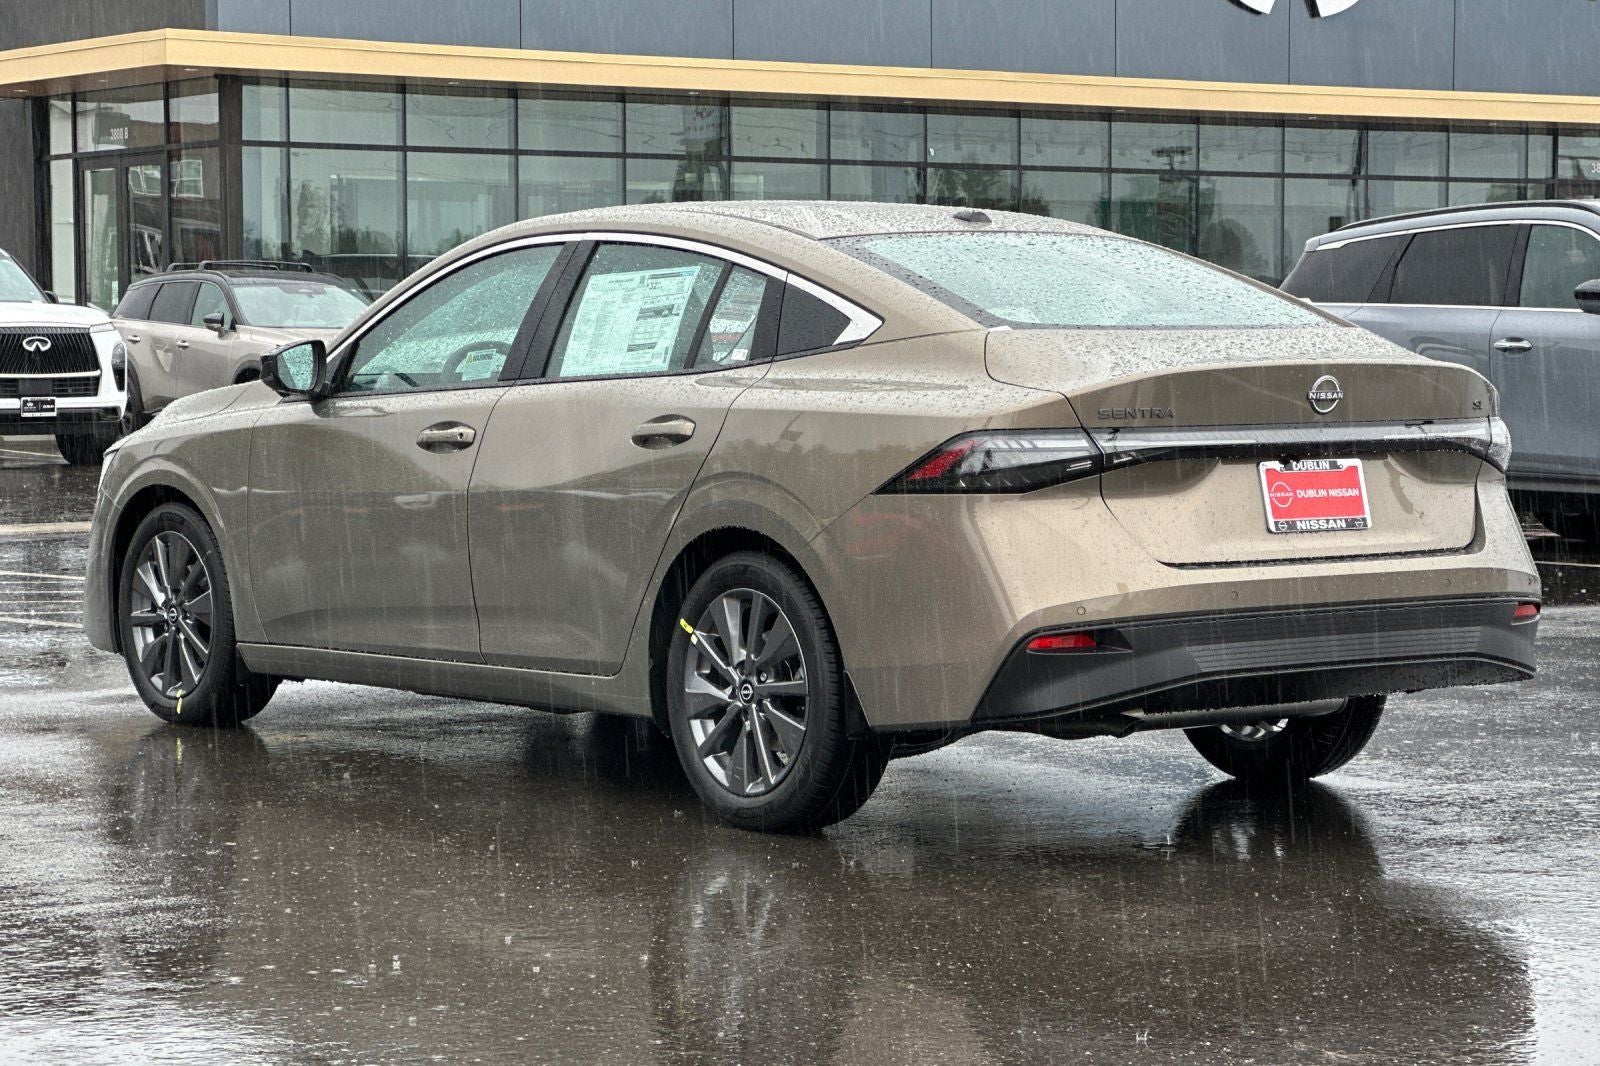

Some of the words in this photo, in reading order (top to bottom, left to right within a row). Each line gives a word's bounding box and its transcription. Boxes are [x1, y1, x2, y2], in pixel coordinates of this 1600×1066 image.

[110, 127, 123, 140] 3800
[1098, 407, 1174, 419] SENTRA
[1292, 460, 1330, 471] DUBLIN
[1296, 489, 1327, 498] DUBLIN
[1328, 488, 1359, 497] NISSAN
[1296, 519, 1346, 529] NISSAN
